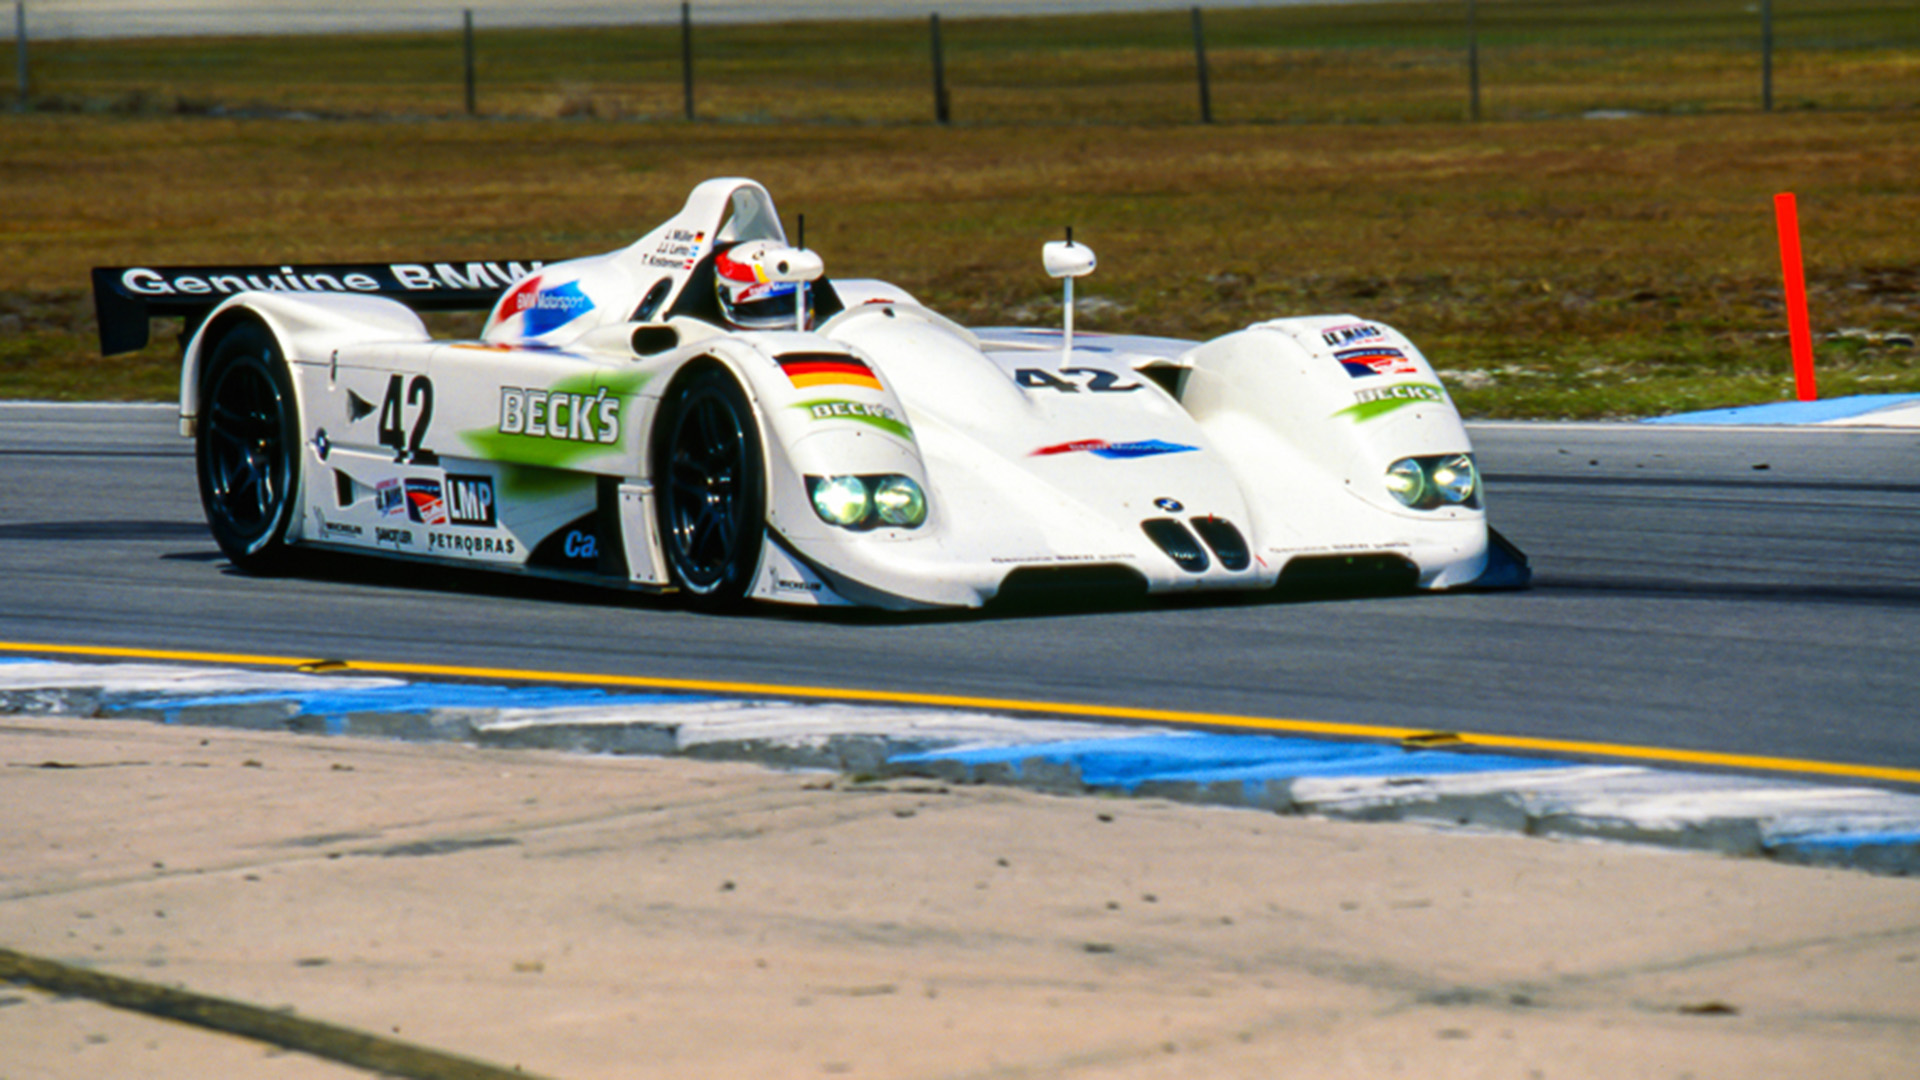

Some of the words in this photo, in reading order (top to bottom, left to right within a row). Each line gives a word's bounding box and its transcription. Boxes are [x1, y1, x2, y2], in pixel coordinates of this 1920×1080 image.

[121, 264, 380, 295] Genuine
[389, 260, 543, 290] BMW
[516, 292, 536, 309] BMW
[1015, 366, 1145, 393] 42
[378, 374, 438, 466] 42
[499, 386, 620, 445] BECK'S
[447, 480, 492, 521] LMP
[428, 532, 515, 555] PETROBRAS
